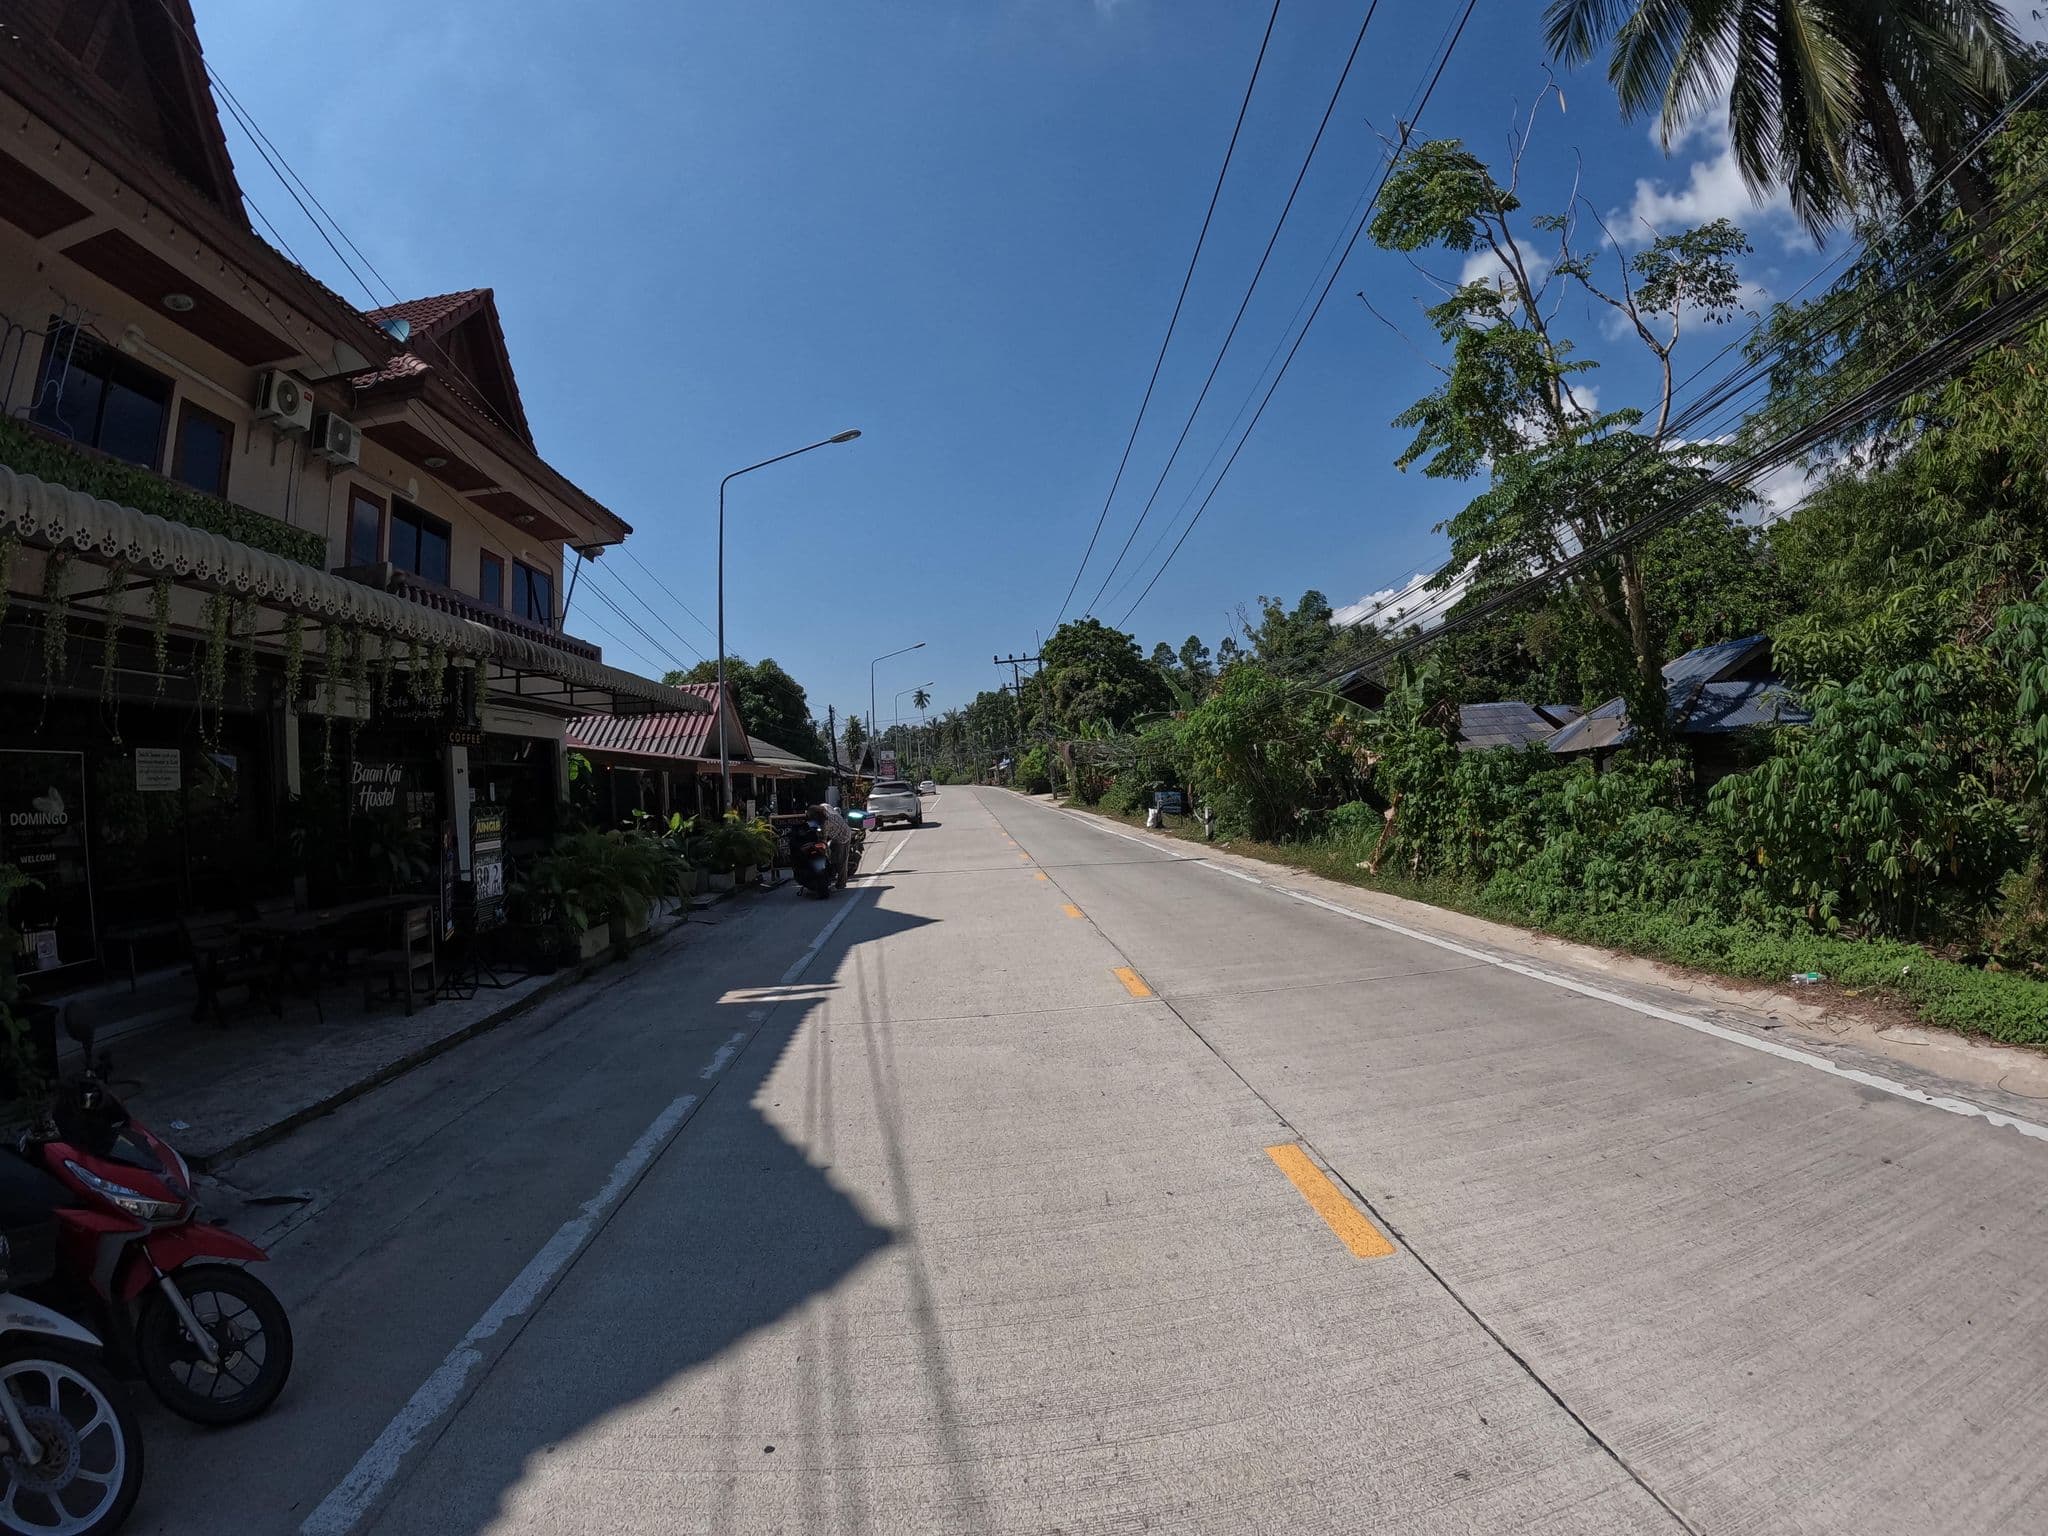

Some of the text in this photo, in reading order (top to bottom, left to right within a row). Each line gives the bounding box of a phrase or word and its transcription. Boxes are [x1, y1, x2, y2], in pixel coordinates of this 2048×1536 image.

[449, 732, 482, 744] COFFEE
[350, 761, 403, 786] Baan Kai
[358, 784, 396, 814] Hostel
[10, 812, 69, 826] DOMINGO
[475, 820, 501, 833] JUNGLE
[20, 853, 56, 864] WELCOME
